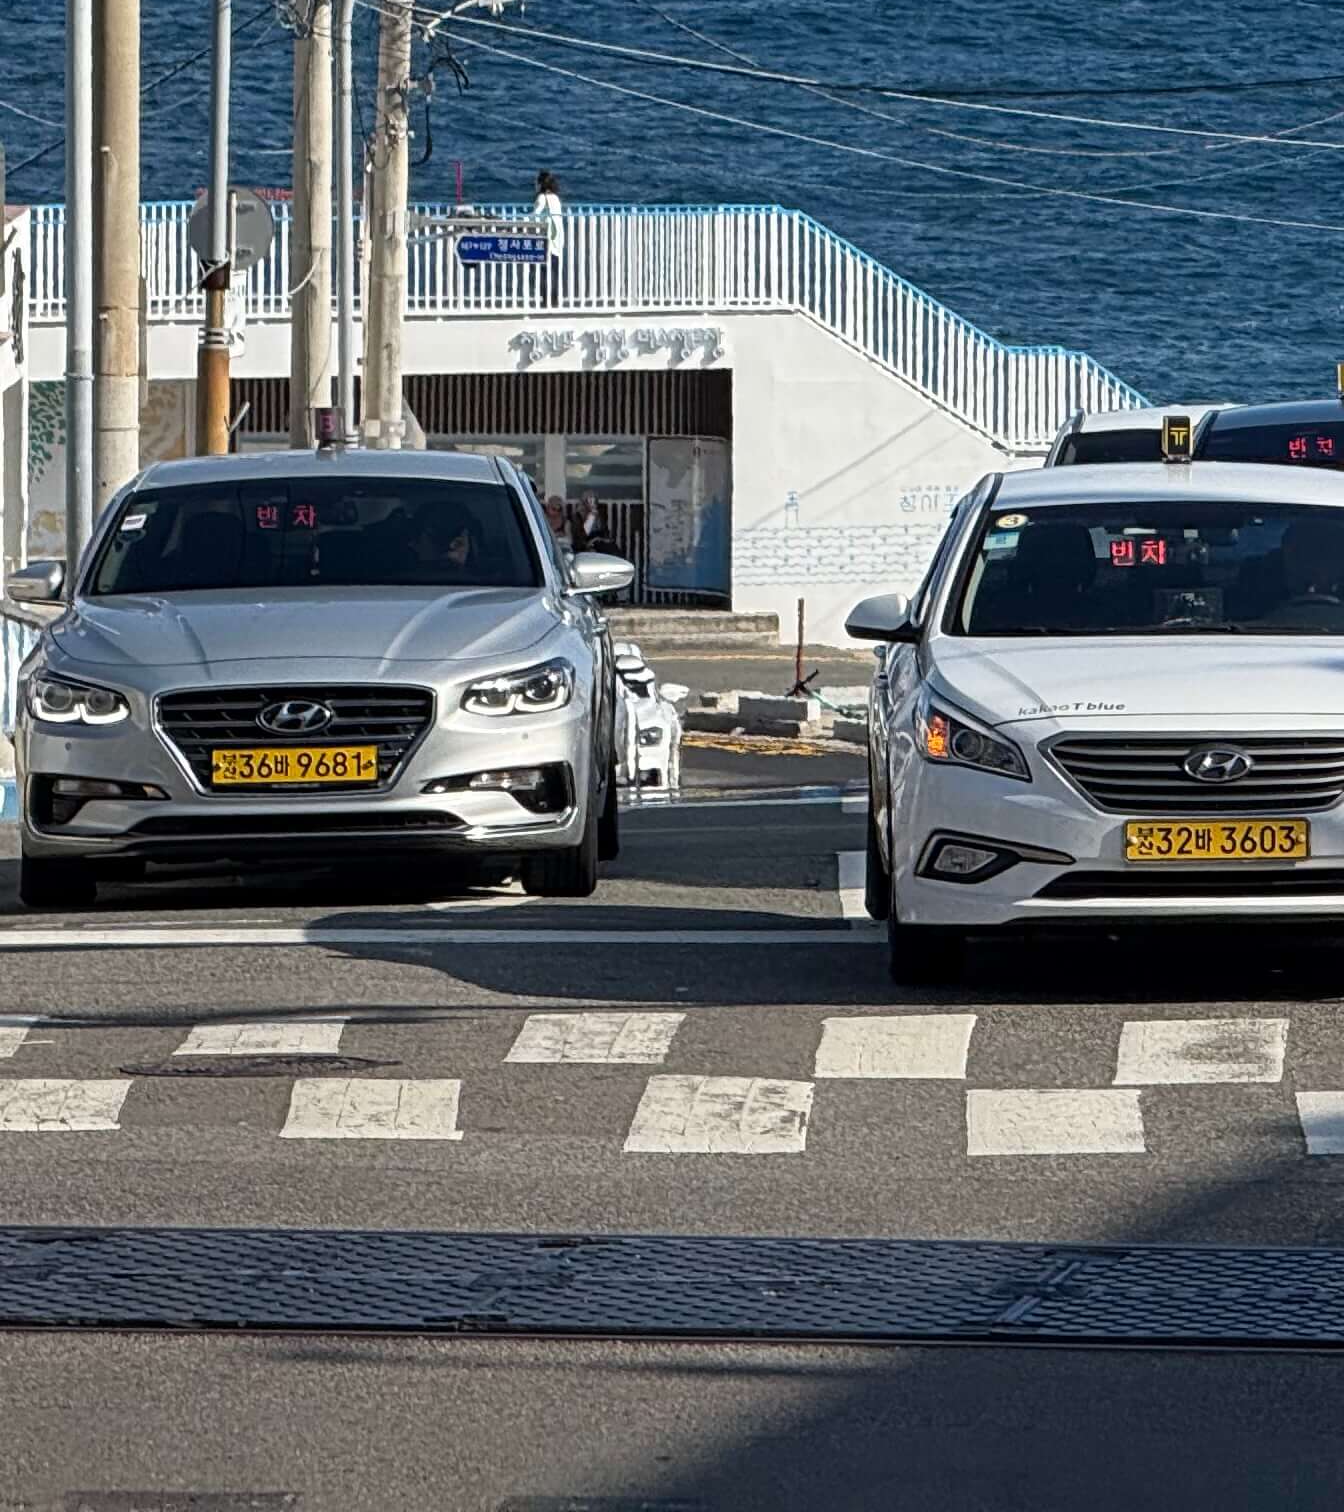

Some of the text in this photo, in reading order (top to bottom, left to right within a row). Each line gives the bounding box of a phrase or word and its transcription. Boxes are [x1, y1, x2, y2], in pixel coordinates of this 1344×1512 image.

[1087, 702, 1126, 711] blue
[297, 751, 362, 778] 9681
[1220, 825, 1296, 854] 3603
